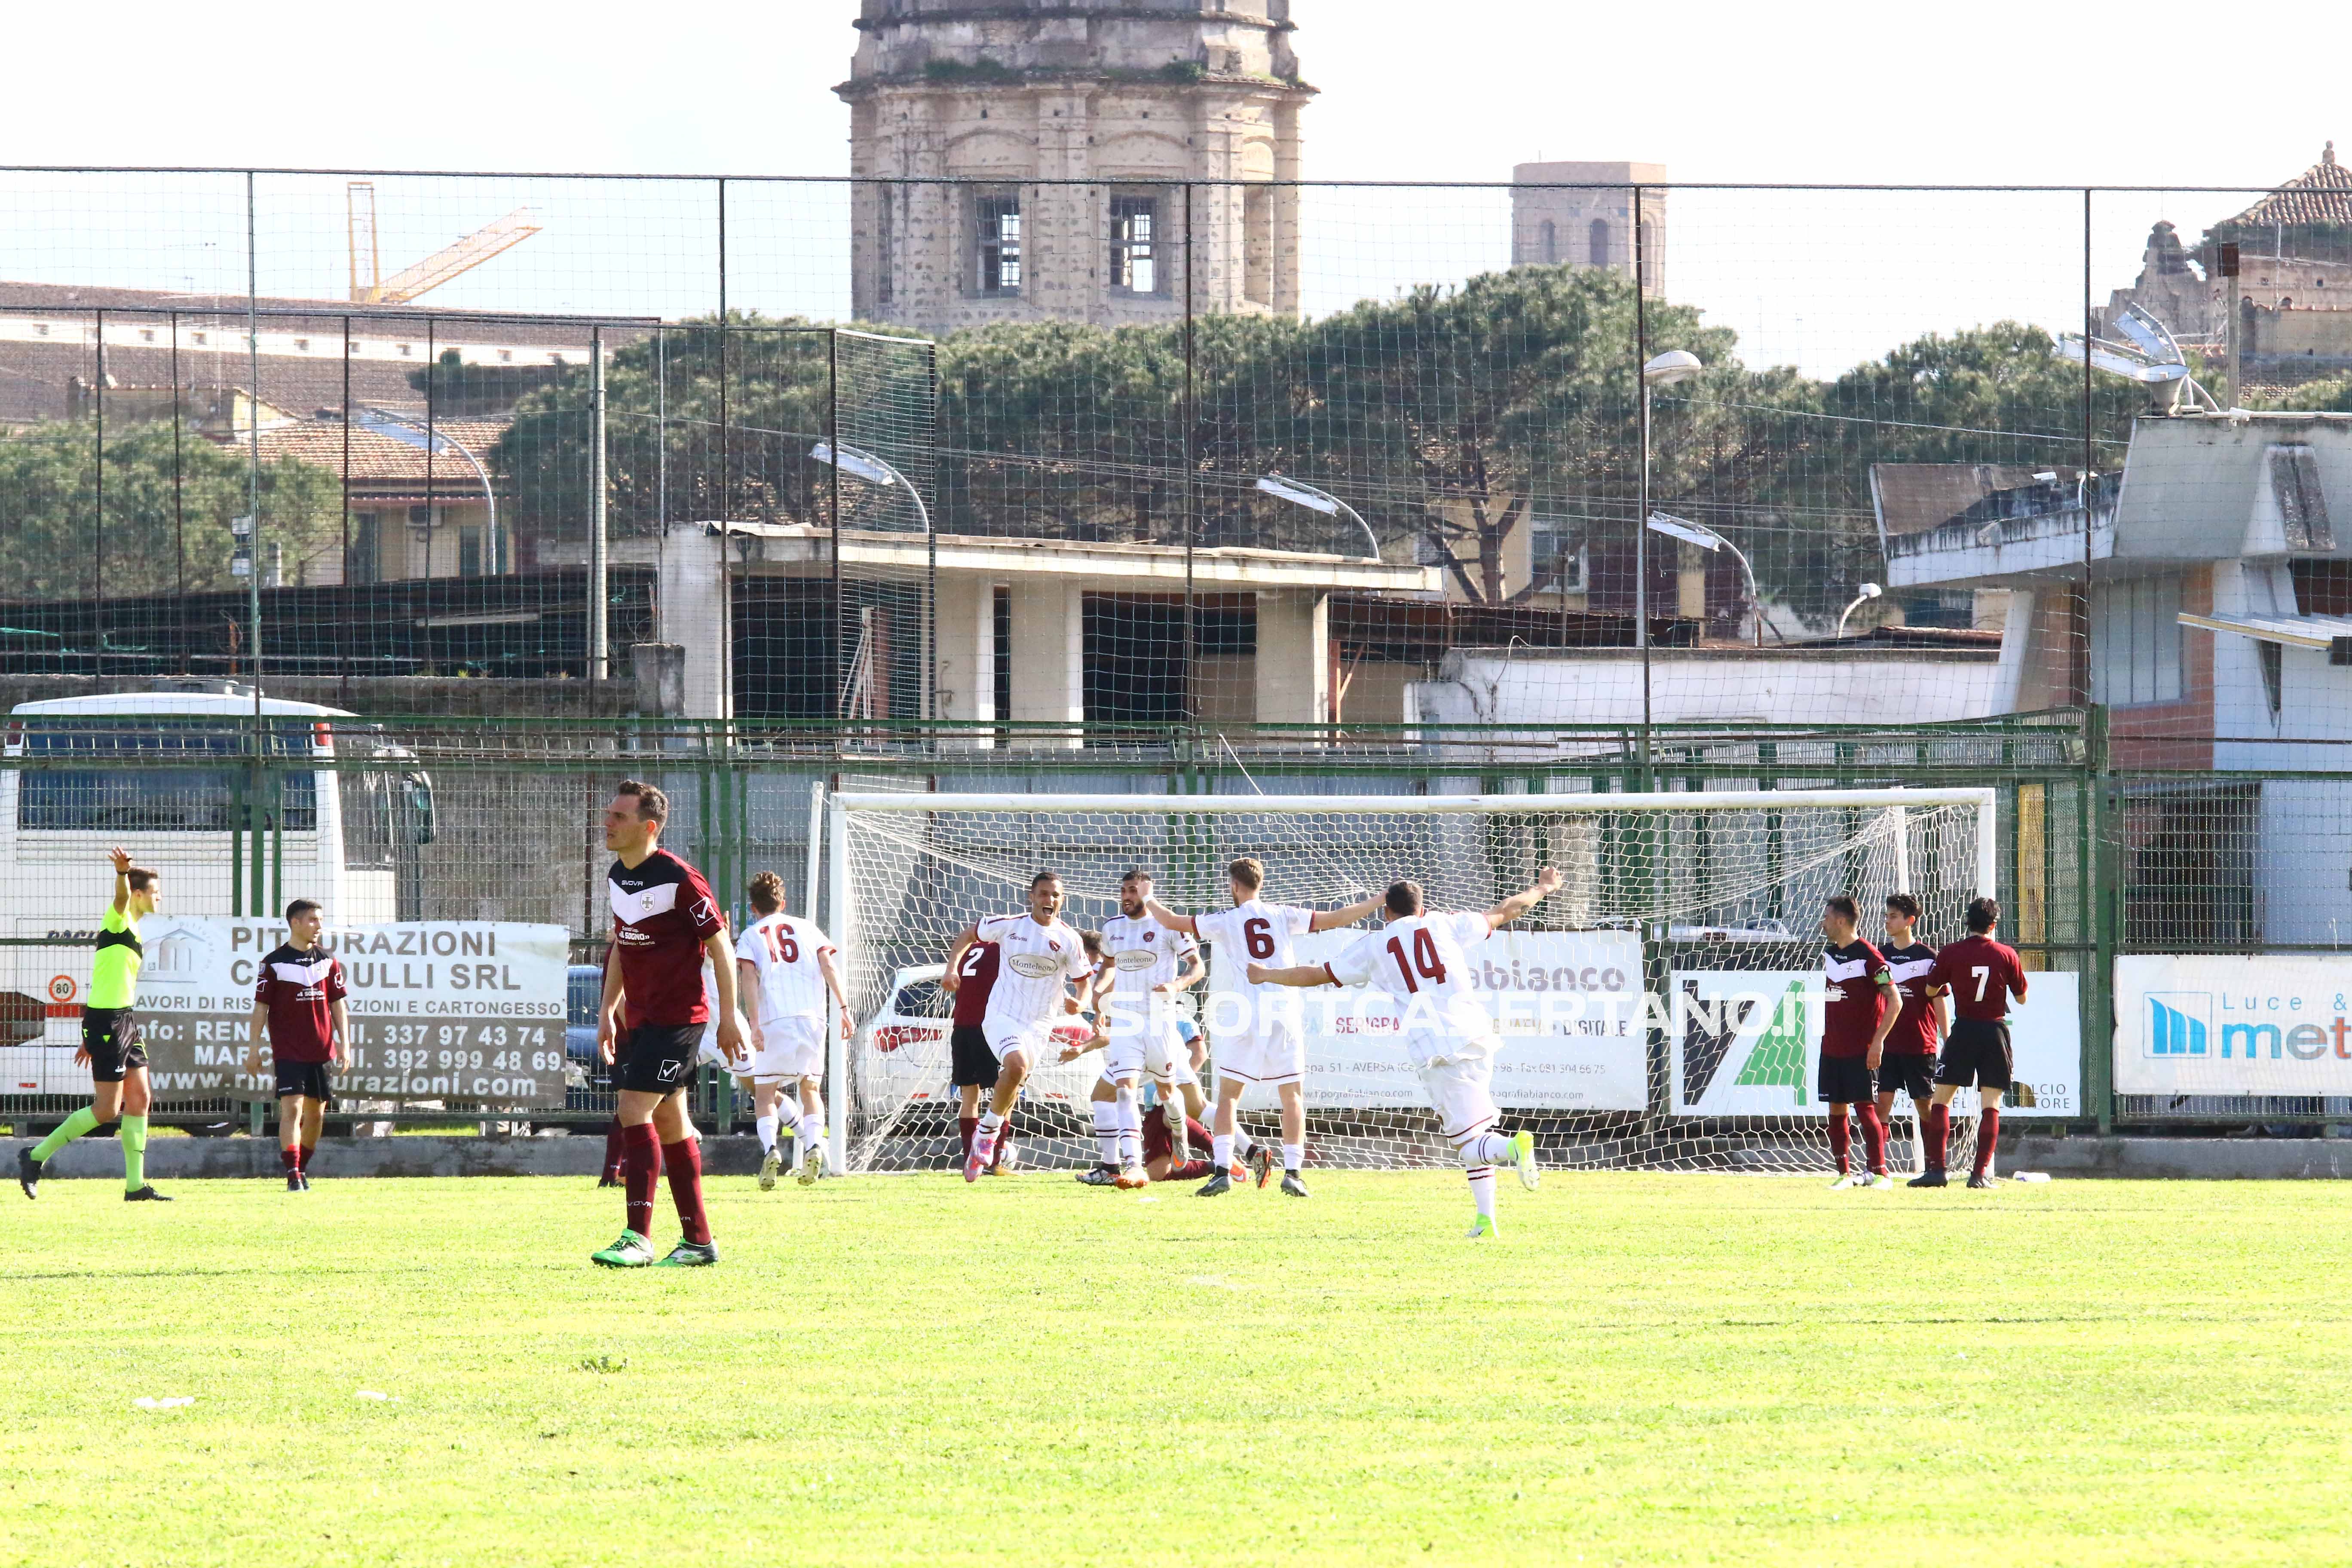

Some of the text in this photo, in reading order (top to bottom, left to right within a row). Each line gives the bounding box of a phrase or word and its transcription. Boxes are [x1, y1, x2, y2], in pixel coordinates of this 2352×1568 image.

[232, 927, 495, 957] PITURAZIONI
[760, 923, 799, 963] 16
[1243, 918, 1275, 959] 6
[962, 947, 984, 977] 2
[1386, 927, 1447, 994] 14
[450, 964, 521, 990] SRL
[1971, 965, 1990, 1002] 7
[133, 995, 190, 1009] AVORI
[199, 996, 214, 1009] DI
[408, 1001, 417, 1013] E
[425, 1000, 561, 1015] CARTONGESSO
[2223, 992, 2347, 1010] Luce &
[138, 1020, 183, 1040] nfo:
[384, 1025, 429, 1044] 337
[439, 1026, 469, 1045] 97
[478, 1026, 507, 1046] 43
[518, 1027, 545, 1046] 74
[194, 1045, 273, 1066] MARC
[384, 1049, 429, 1069] 392
[439, 1050, 483, 1070] 999
[493, 1051, 522, 1070] 48
[532, 1052, 561, 1071] 69
[1352, 1063, 1394, 1073] AVERSA
